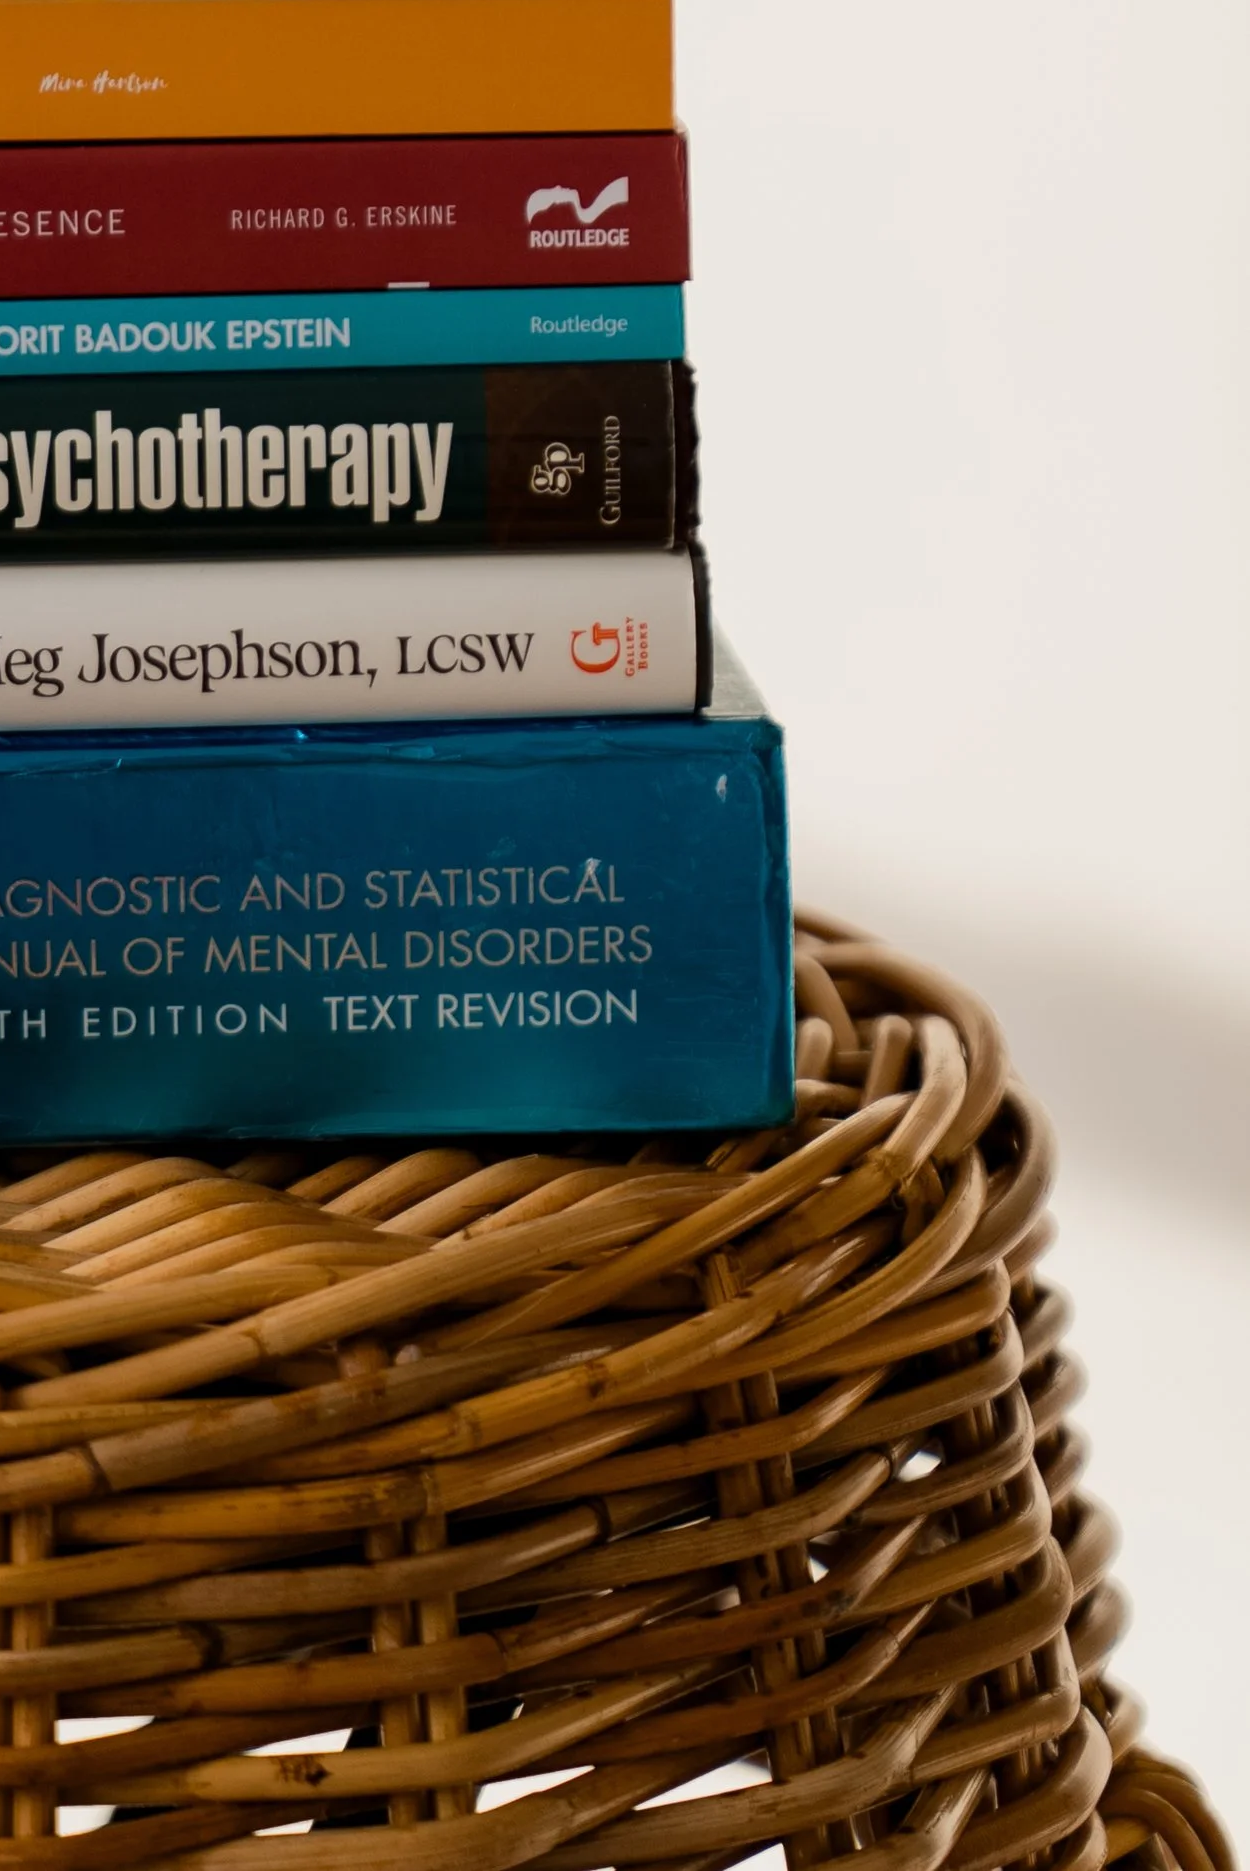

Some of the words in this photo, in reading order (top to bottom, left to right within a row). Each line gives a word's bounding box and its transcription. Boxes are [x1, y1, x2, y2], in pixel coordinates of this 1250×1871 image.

[231, 208, 326, 231] RICHARD
[336, 207, 357, 227] G.
[366, 204, 456, 226] ERSKINE
[530, 228, 630, 248] ROUTLEDGE
[75, 321, 215, 353] BADOUK
[227, 318, 350, 350] EPSTEIN
[530, 315, 628, 337] Routledge
[600, 415, 621, 524] GUILFORD
[78, 629, 378, 693] Josephson,
[397, 632, 534, 675] LCSW
[625, 617, 635, 677] GALLERY
[638, 622, 648, 670] BOOKS
[240, 872, 345, 911] AND
[363, 865, 624, 909] STATISTICAL
[122, 935, 185, 976] OF
[205, 930, 386, 973] MENTAL
[405, 925, 653, 968] DISORDERS
[83, 1003, 287, 1039] EDITION
[324, 995, 418, 1033] TEXT
[438, 989, 637, 1029] REVISION
